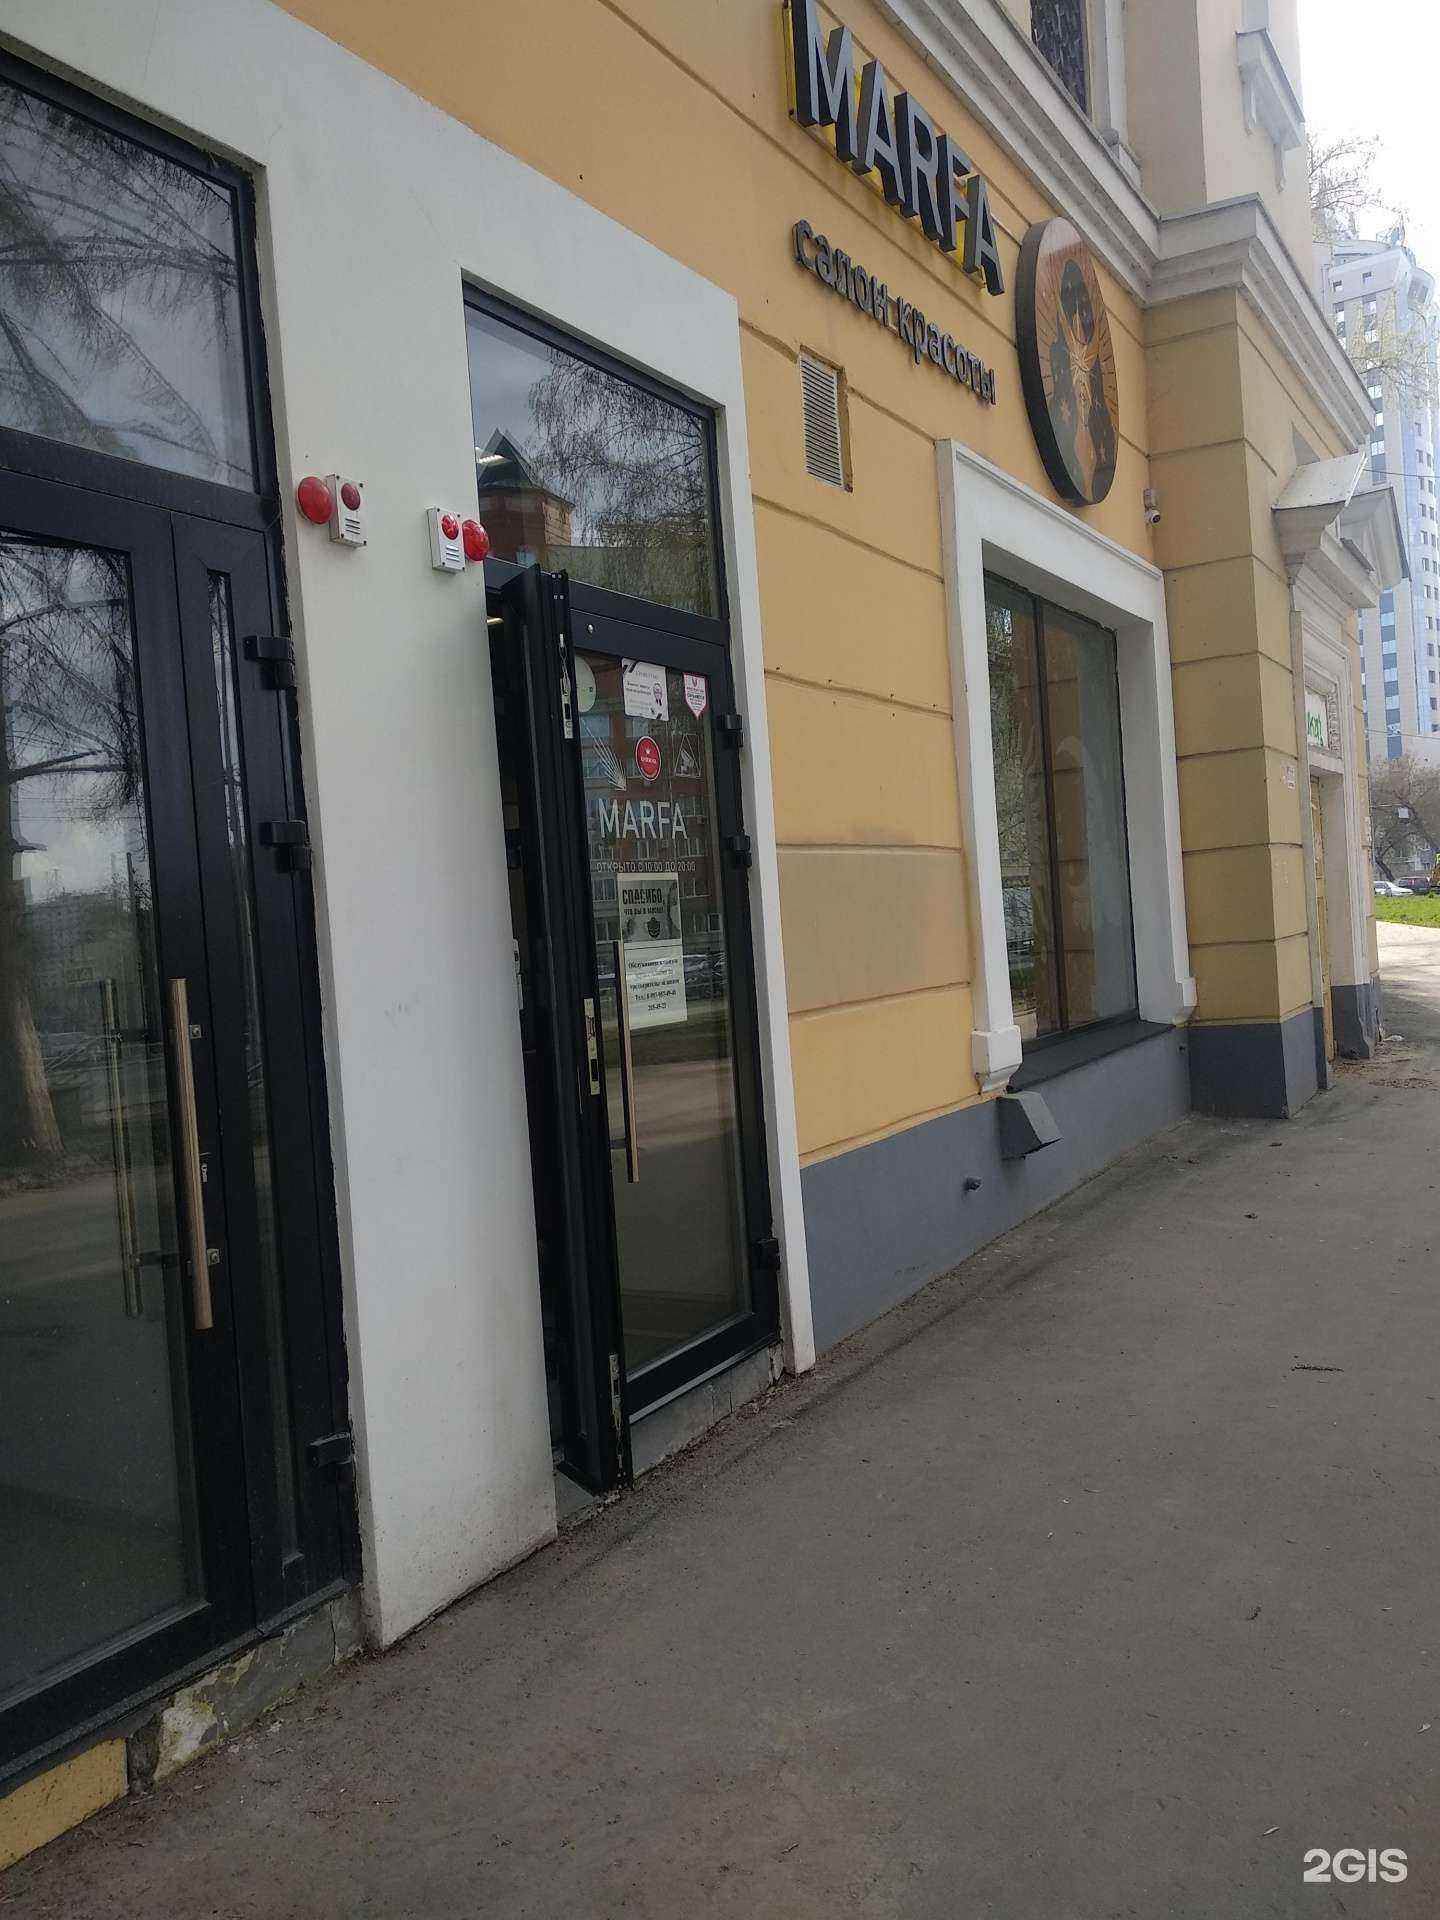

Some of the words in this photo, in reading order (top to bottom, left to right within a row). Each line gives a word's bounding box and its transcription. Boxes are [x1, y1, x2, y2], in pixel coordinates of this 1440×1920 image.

[790, 0, 1005, 296] MARFA
[792, 219, 889, 328] салон
[897, 296, 996, 405] красоты
[598, 798, 688, 839] MARFA
[596, 861, 636, 873] ОТКРЫТО
[622, 887, 665, 906] СПАСИБО,
